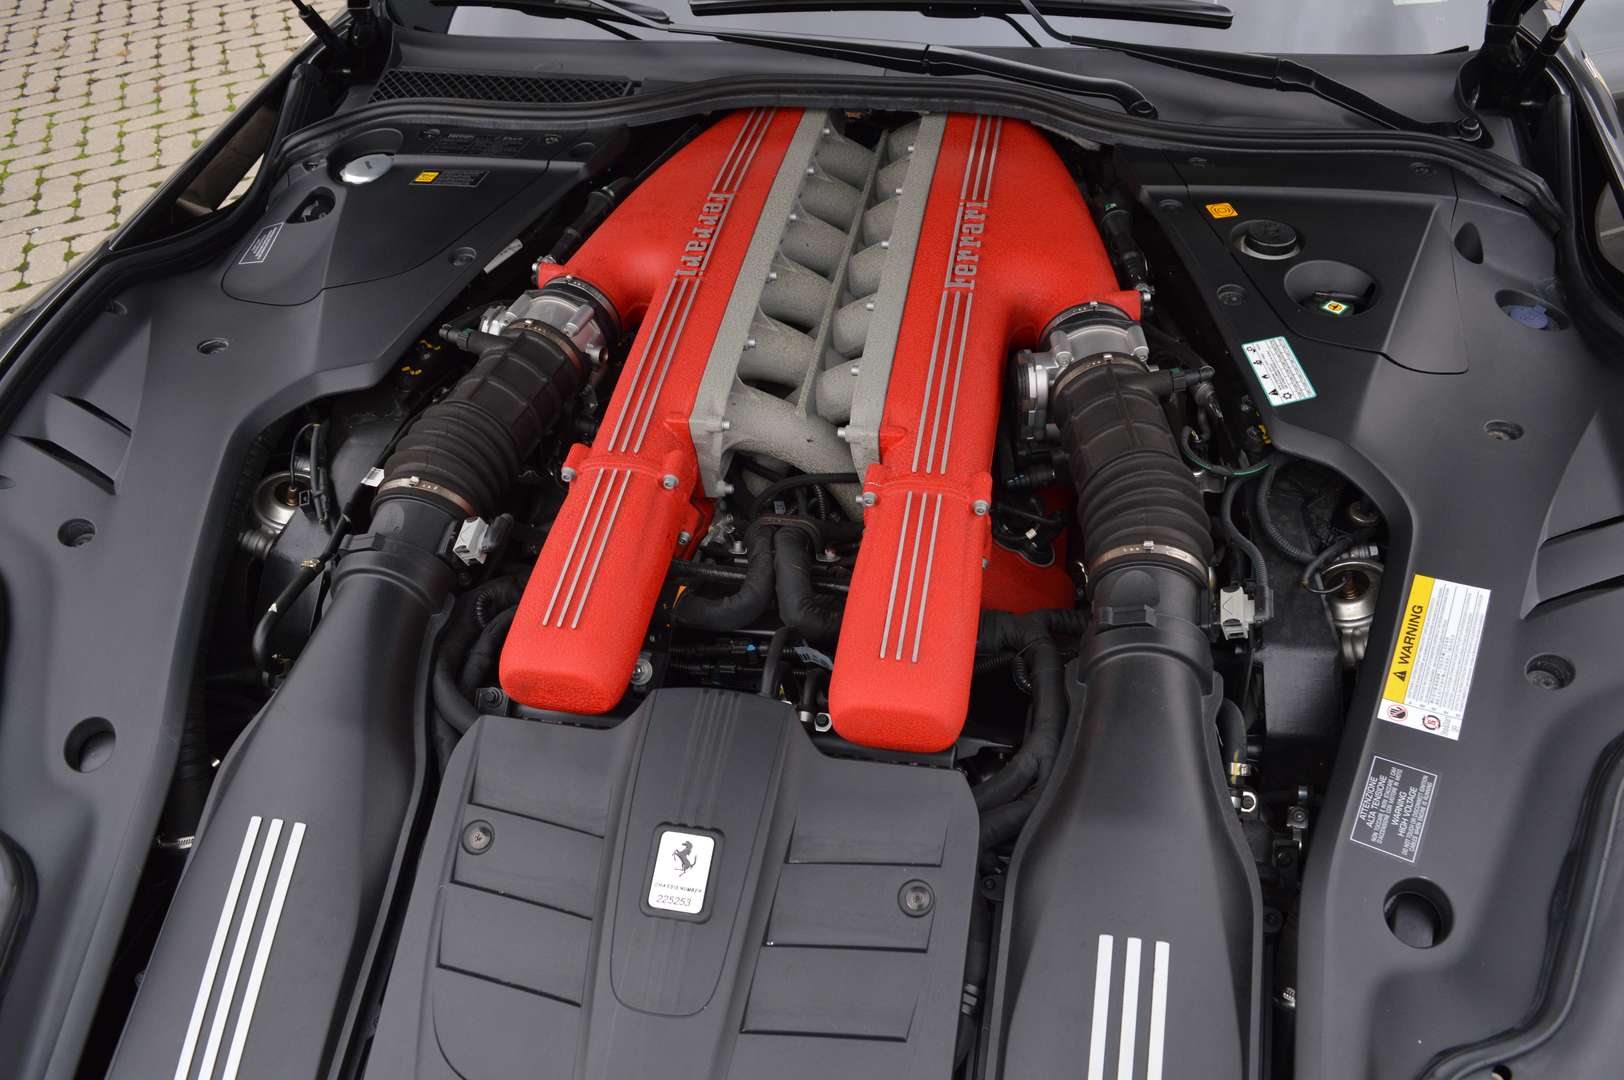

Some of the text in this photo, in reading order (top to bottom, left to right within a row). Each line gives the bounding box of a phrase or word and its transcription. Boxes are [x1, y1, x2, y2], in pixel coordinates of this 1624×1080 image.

[675, 192, 735, 276] Ferrari
[944, 202, 988, 290] Ferrari
[1398, 604, 1424, 665] WARNING
[1359, 776, 1378, 821] ATTENZIONE
[1366, 775, 1387, 828] ALTA TENSIONE
[1391, 791, 1407, 826] WARNING
[1397, 786, 1418, 837] HIGH VOLTAGE
[656, 894, 692, 907] 225253
